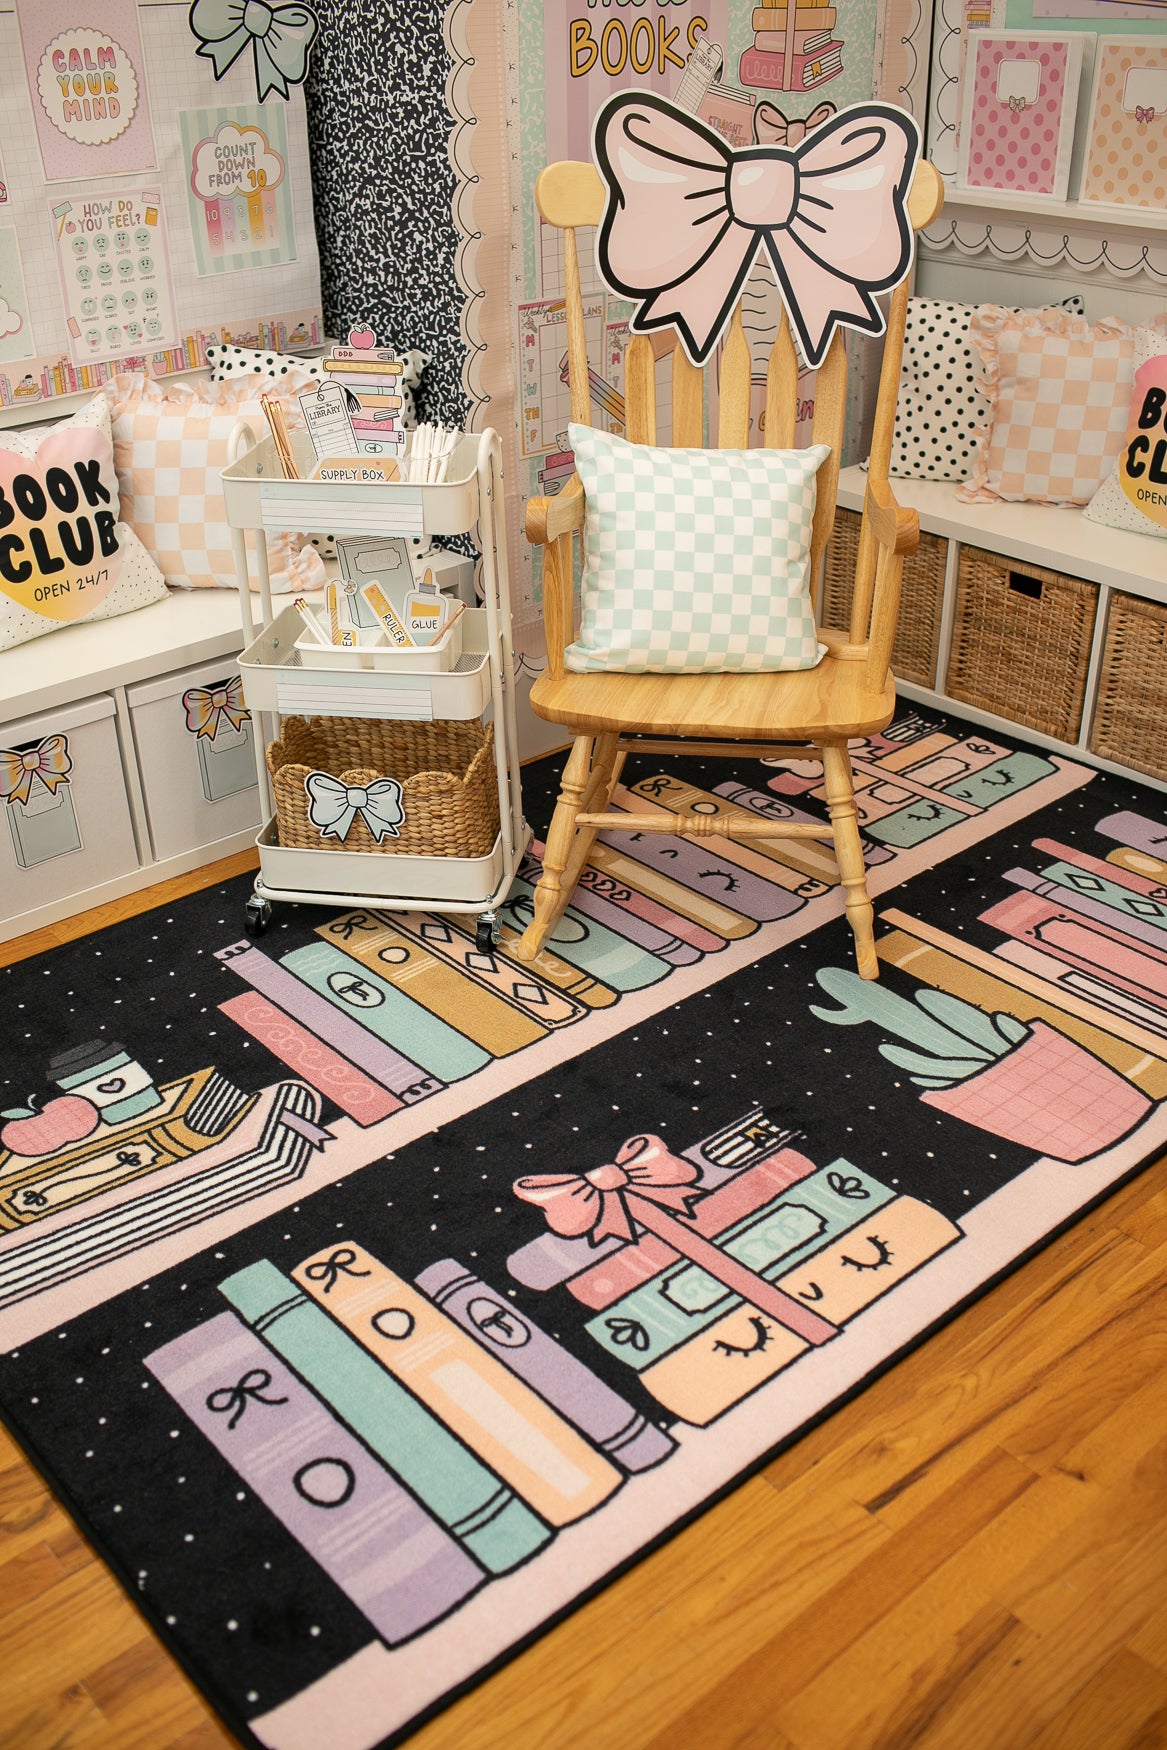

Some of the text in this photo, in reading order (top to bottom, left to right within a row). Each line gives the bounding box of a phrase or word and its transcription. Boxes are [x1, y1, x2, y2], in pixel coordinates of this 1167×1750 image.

[52, 46, 116, 73] CALM
[56, 71, 118, 97] YOUR
[63, 97, 120, 122] MIND
[214, 142, 257, 159] COUNT
[218, 156, 256, 173] DOWN
[208, 168, 267, 188] FROM 10
[83, 200, 133, 218] HOW DO
[206, 209, 219, 222] 10
[251, 205, 259, 217] 7
[78, 217, 103, 234] YOU
[225, 231, 235, 243] 4
[546, 305, 603, 323] LESS LANS
[525, 334, 536, 347] M
[527, 359, 535, 372] T
[611, 352, 621, 365] M
[526, 382, 538, 396] W
[611, 375, 620, 388] T
[309, 404, 341, 420] LIBRARY
[524, 407, 540, 421] TH
[529, 428, 538, 442] F
[320, 468, 385, 480] SUPPLY BOX
[0, 510, 119, 583] CLUB
[34, 569, 110, 601] OPEN 24/7
[382, 612, 406, 645] RULER
[411, 619, 438, 630] GLUE
[341, 631, 353, 647] EN
